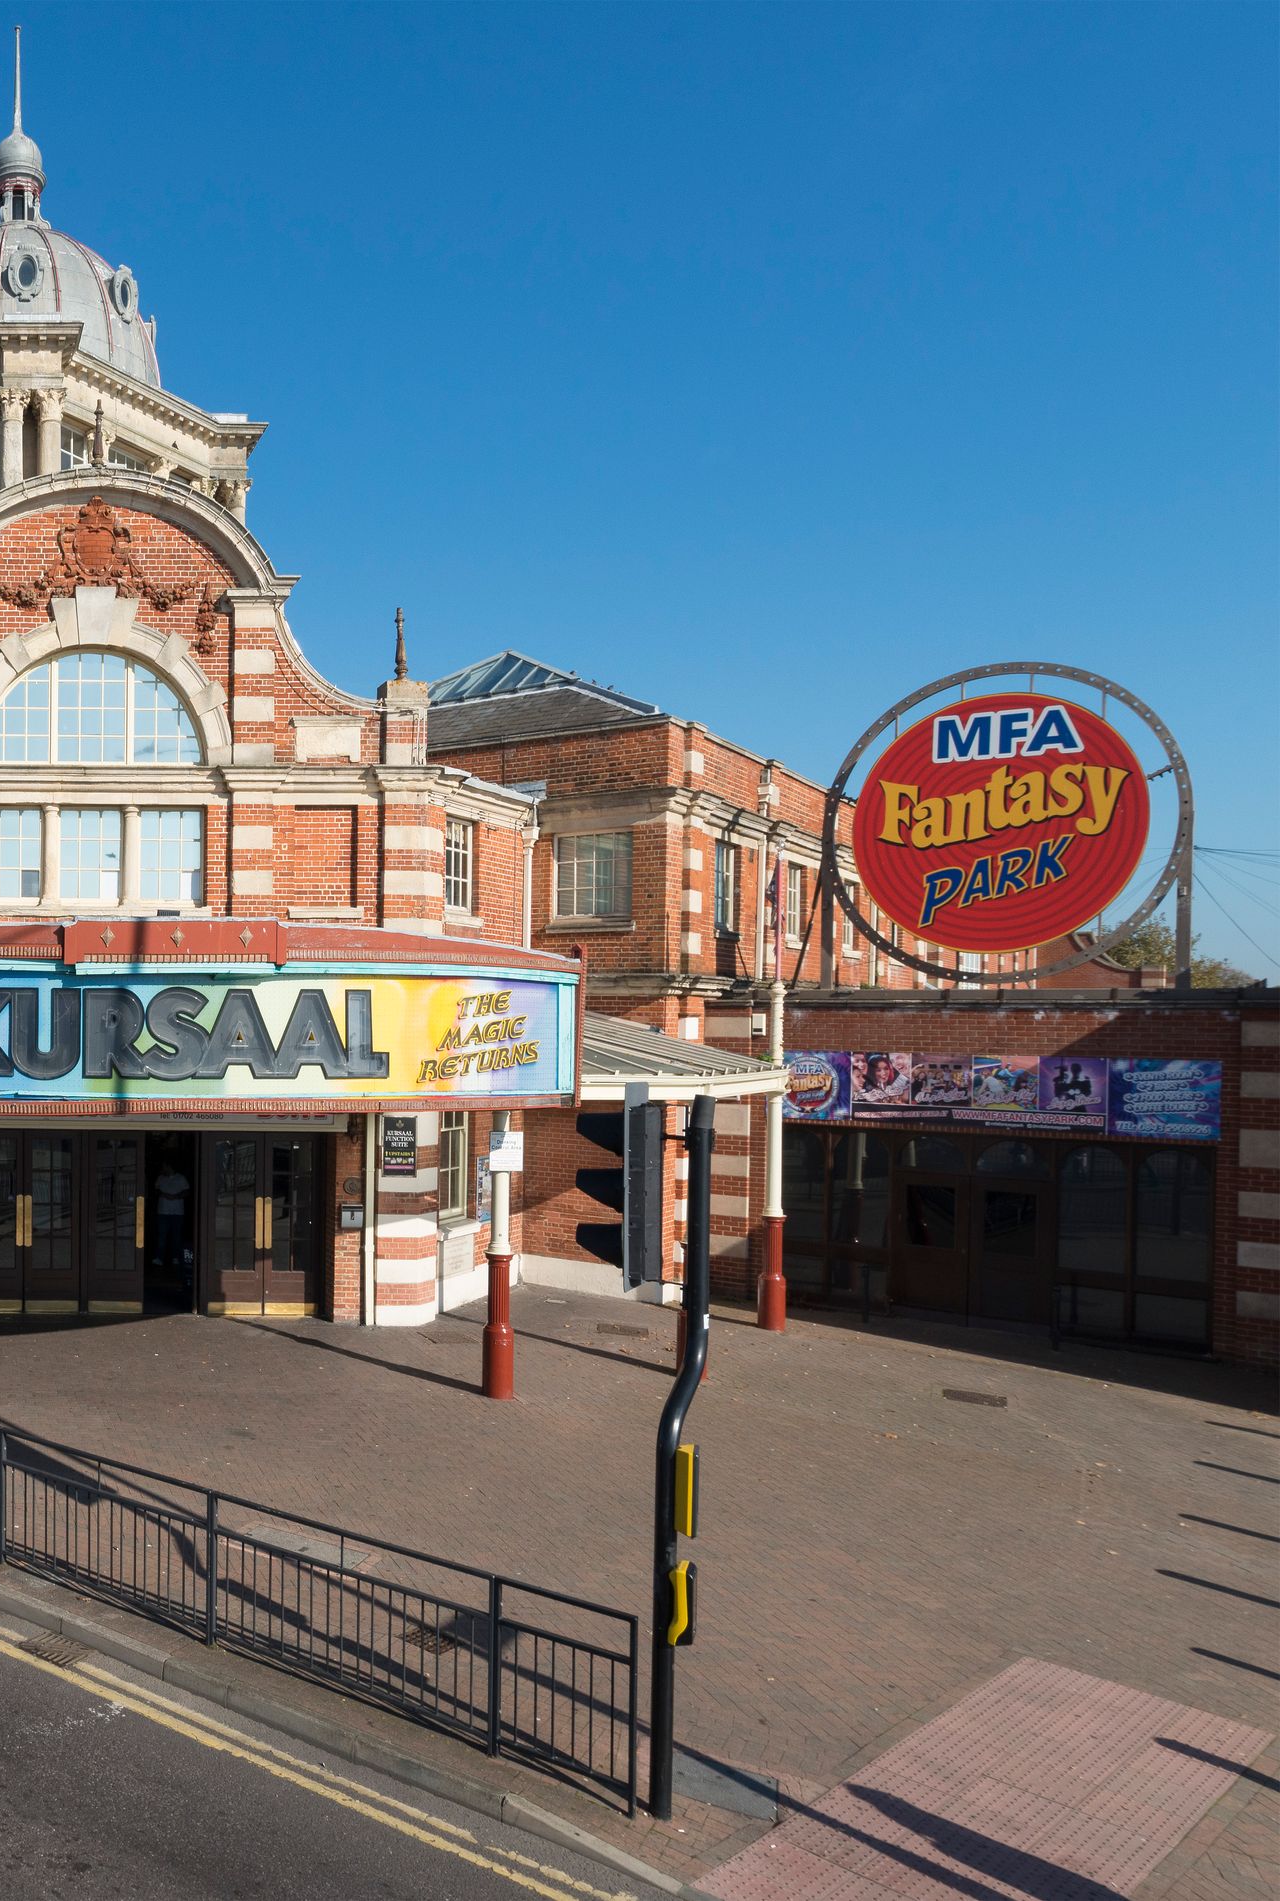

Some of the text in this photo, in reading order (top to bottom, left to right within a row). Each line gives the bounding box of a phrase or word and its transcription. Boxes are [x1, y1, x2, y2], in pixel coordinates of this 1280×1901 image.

[932, 705, 1084, 763] MFA
[877, 762, 1133, 851] Fantasy
[918, 833, 1075, 929] PARK
[457, 989, 513, 1020] THE
[436, 1014, 528, 1051] MAGIC
[417, 1040, 540, 1083] RETURNS
[795, 1063, 825, 1075] MFA
[1134, 1071, 1166, 1080] EVENTS
[952, 1109, 1104, 1127] WWW.MFAFANTASYPARK.COM
